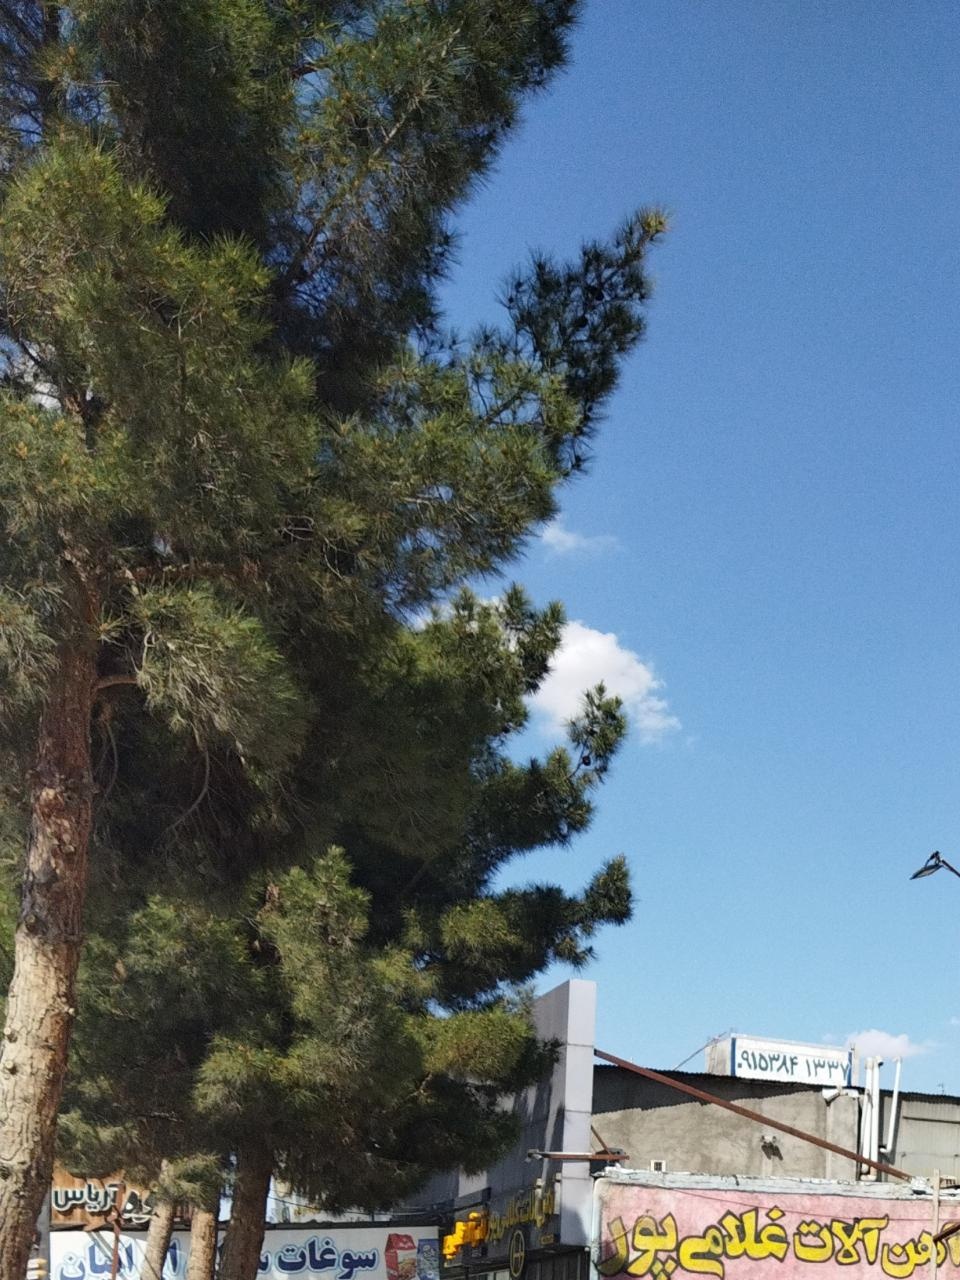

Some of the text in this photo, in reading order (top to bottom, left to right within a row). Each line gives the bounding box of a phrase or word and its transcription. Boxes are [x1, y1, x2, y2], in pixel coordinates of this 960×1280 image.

[738, 1050, 850, 1080] ۰۹۱۵۳۸۴ ۱۳۳۷
[793, 1213, 889, 1266] آلات
